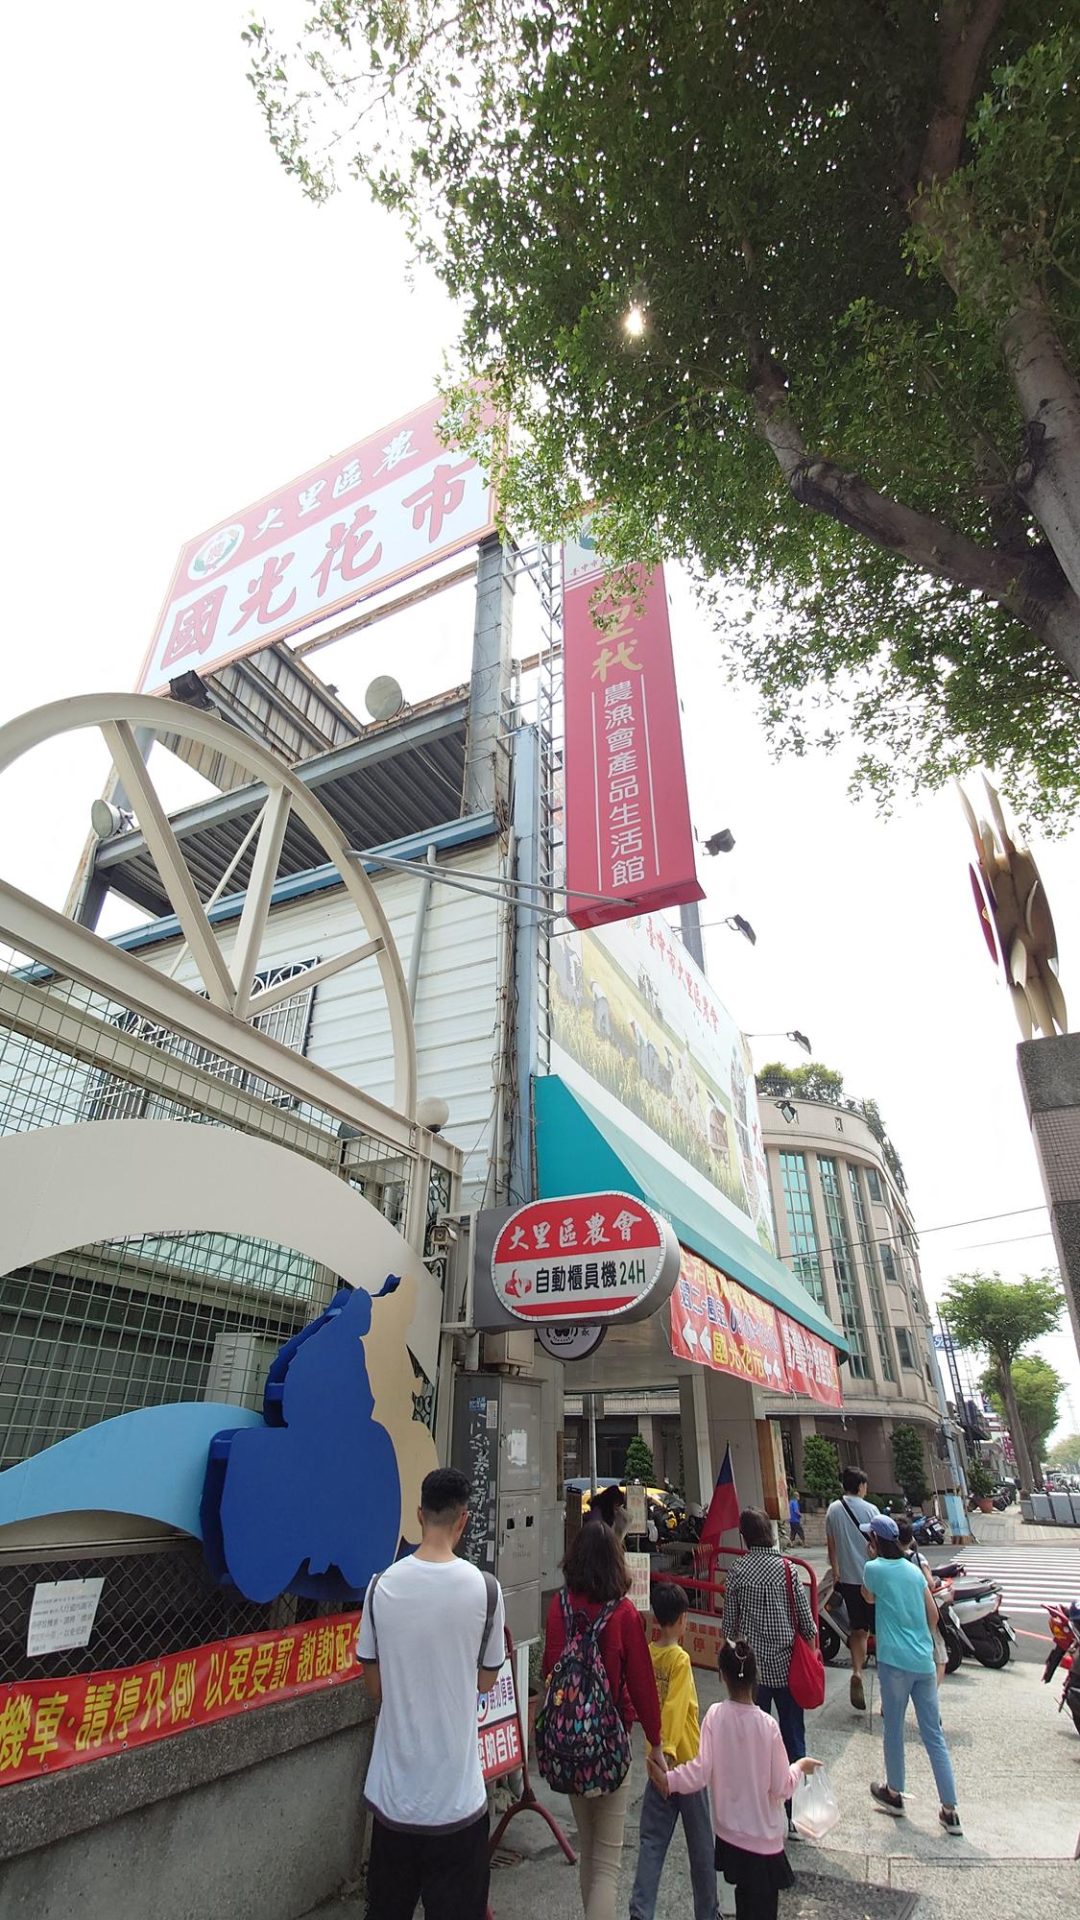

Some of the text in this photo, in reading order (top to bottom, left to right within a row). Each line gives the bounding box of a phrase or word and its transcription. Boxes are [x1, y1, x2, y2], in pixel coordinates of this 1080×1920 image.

[160, 457, 478, 670] 國光花市
[604, 680, 645, 888] 農漁會產品生活館
[508, 1209, 642, 1250] 大里區農會
[203, 1638, 295, 1711] 以免受罰
[296, 1622, 362, 1682] 謝謝配
